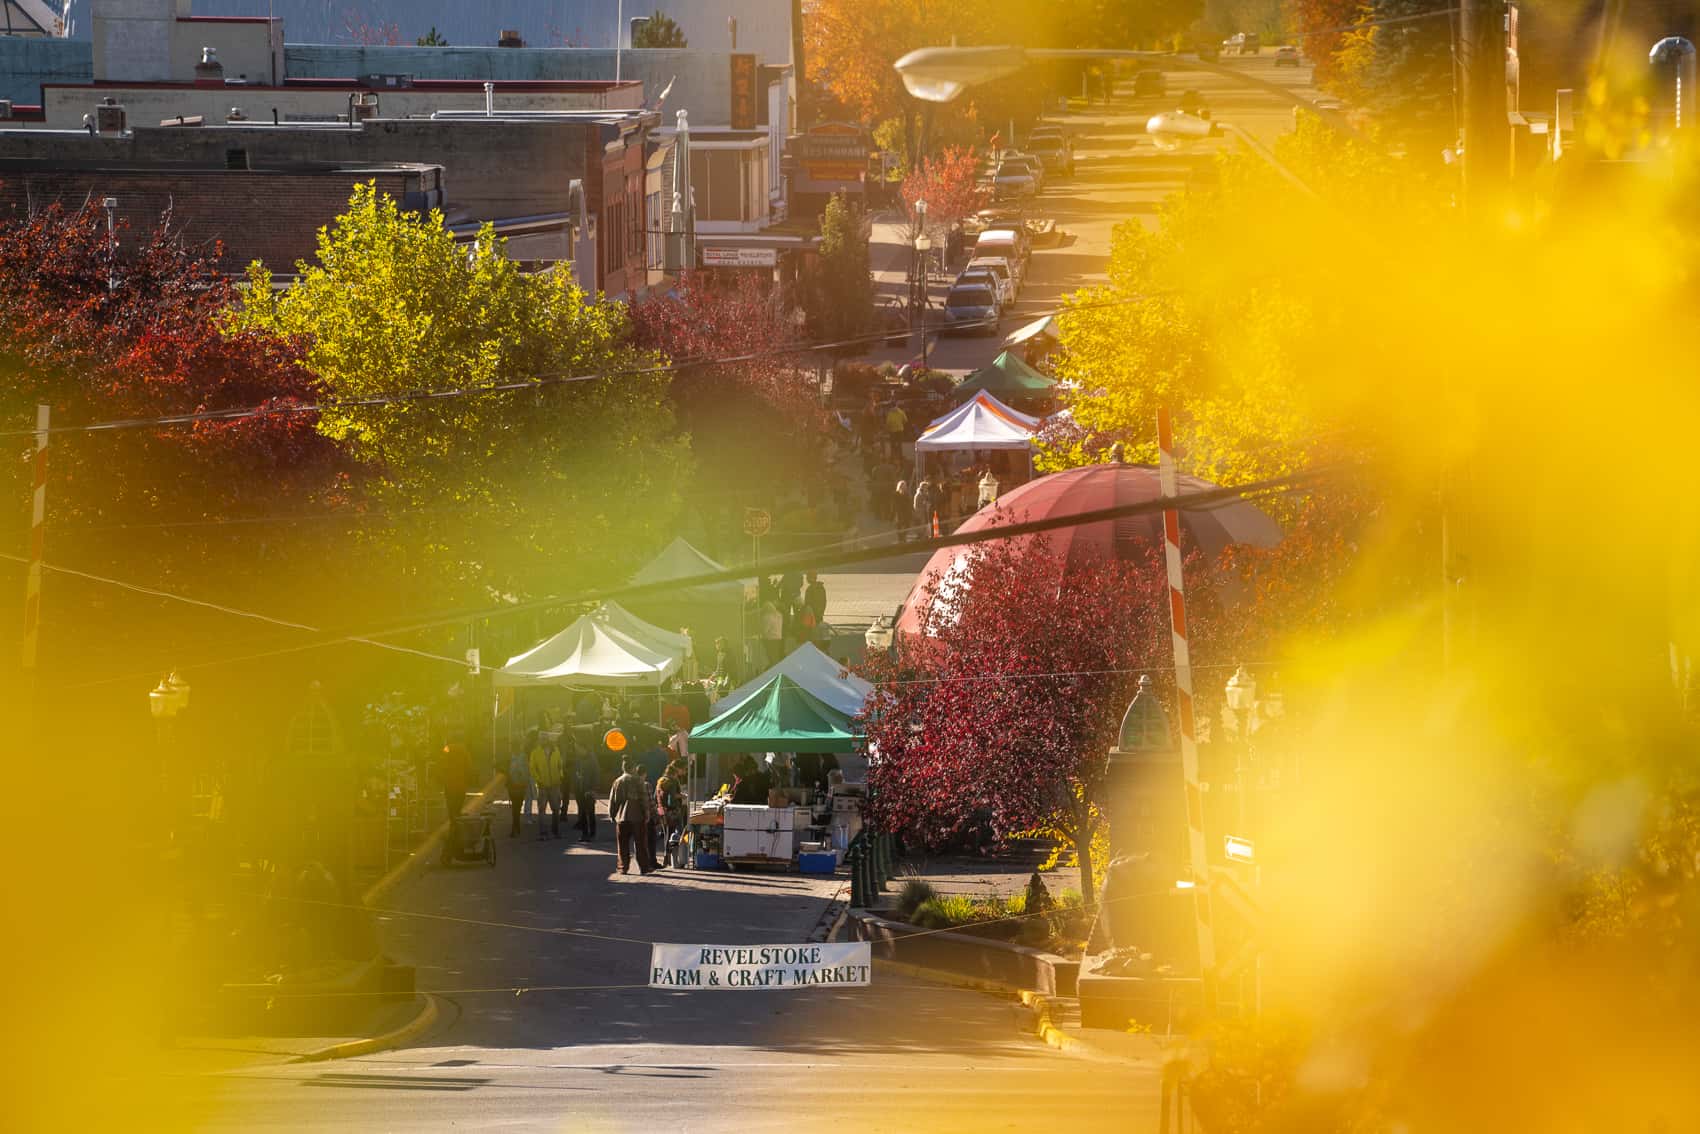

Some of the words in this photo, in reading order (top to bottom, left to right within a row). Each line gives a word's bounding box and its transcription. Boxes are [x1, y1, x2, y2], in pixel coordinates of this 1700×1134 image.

[700, 947, 821, 965] REVELSTOKE
[652, 967, 701, 986] FARM
[708, 970, 720, 986] &
[727, 969, 787, 987] CRAFT
[793, 965, 869, 986] MARKET
